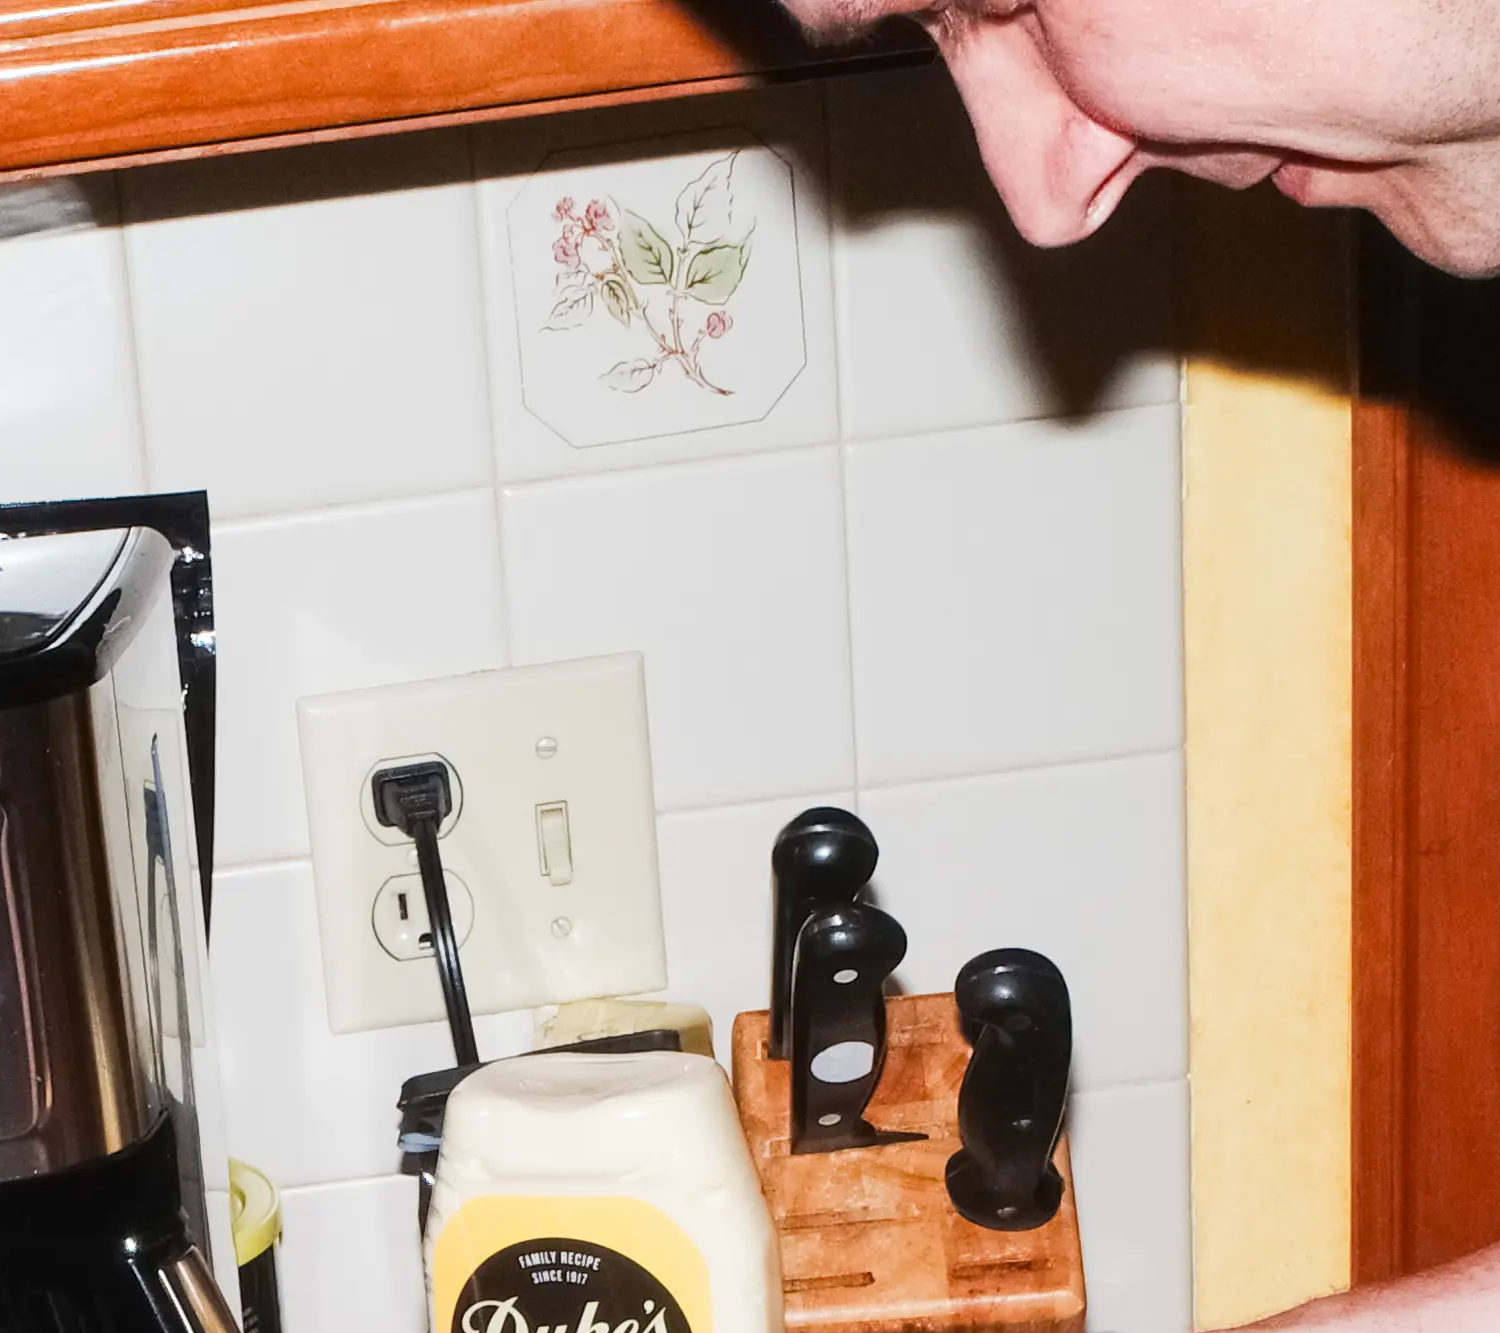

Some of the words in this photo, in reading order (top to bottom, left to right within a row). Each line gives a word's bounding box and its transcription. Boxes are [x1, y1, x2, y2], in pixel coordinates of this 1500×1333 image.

[518, 1251, 557, 1269] FAMILY
[560, 1251, 602, 1271] RECIPE
[531, 1269, 563, 1285] SINCE
[566, 1270, 588, 1285] 1917
